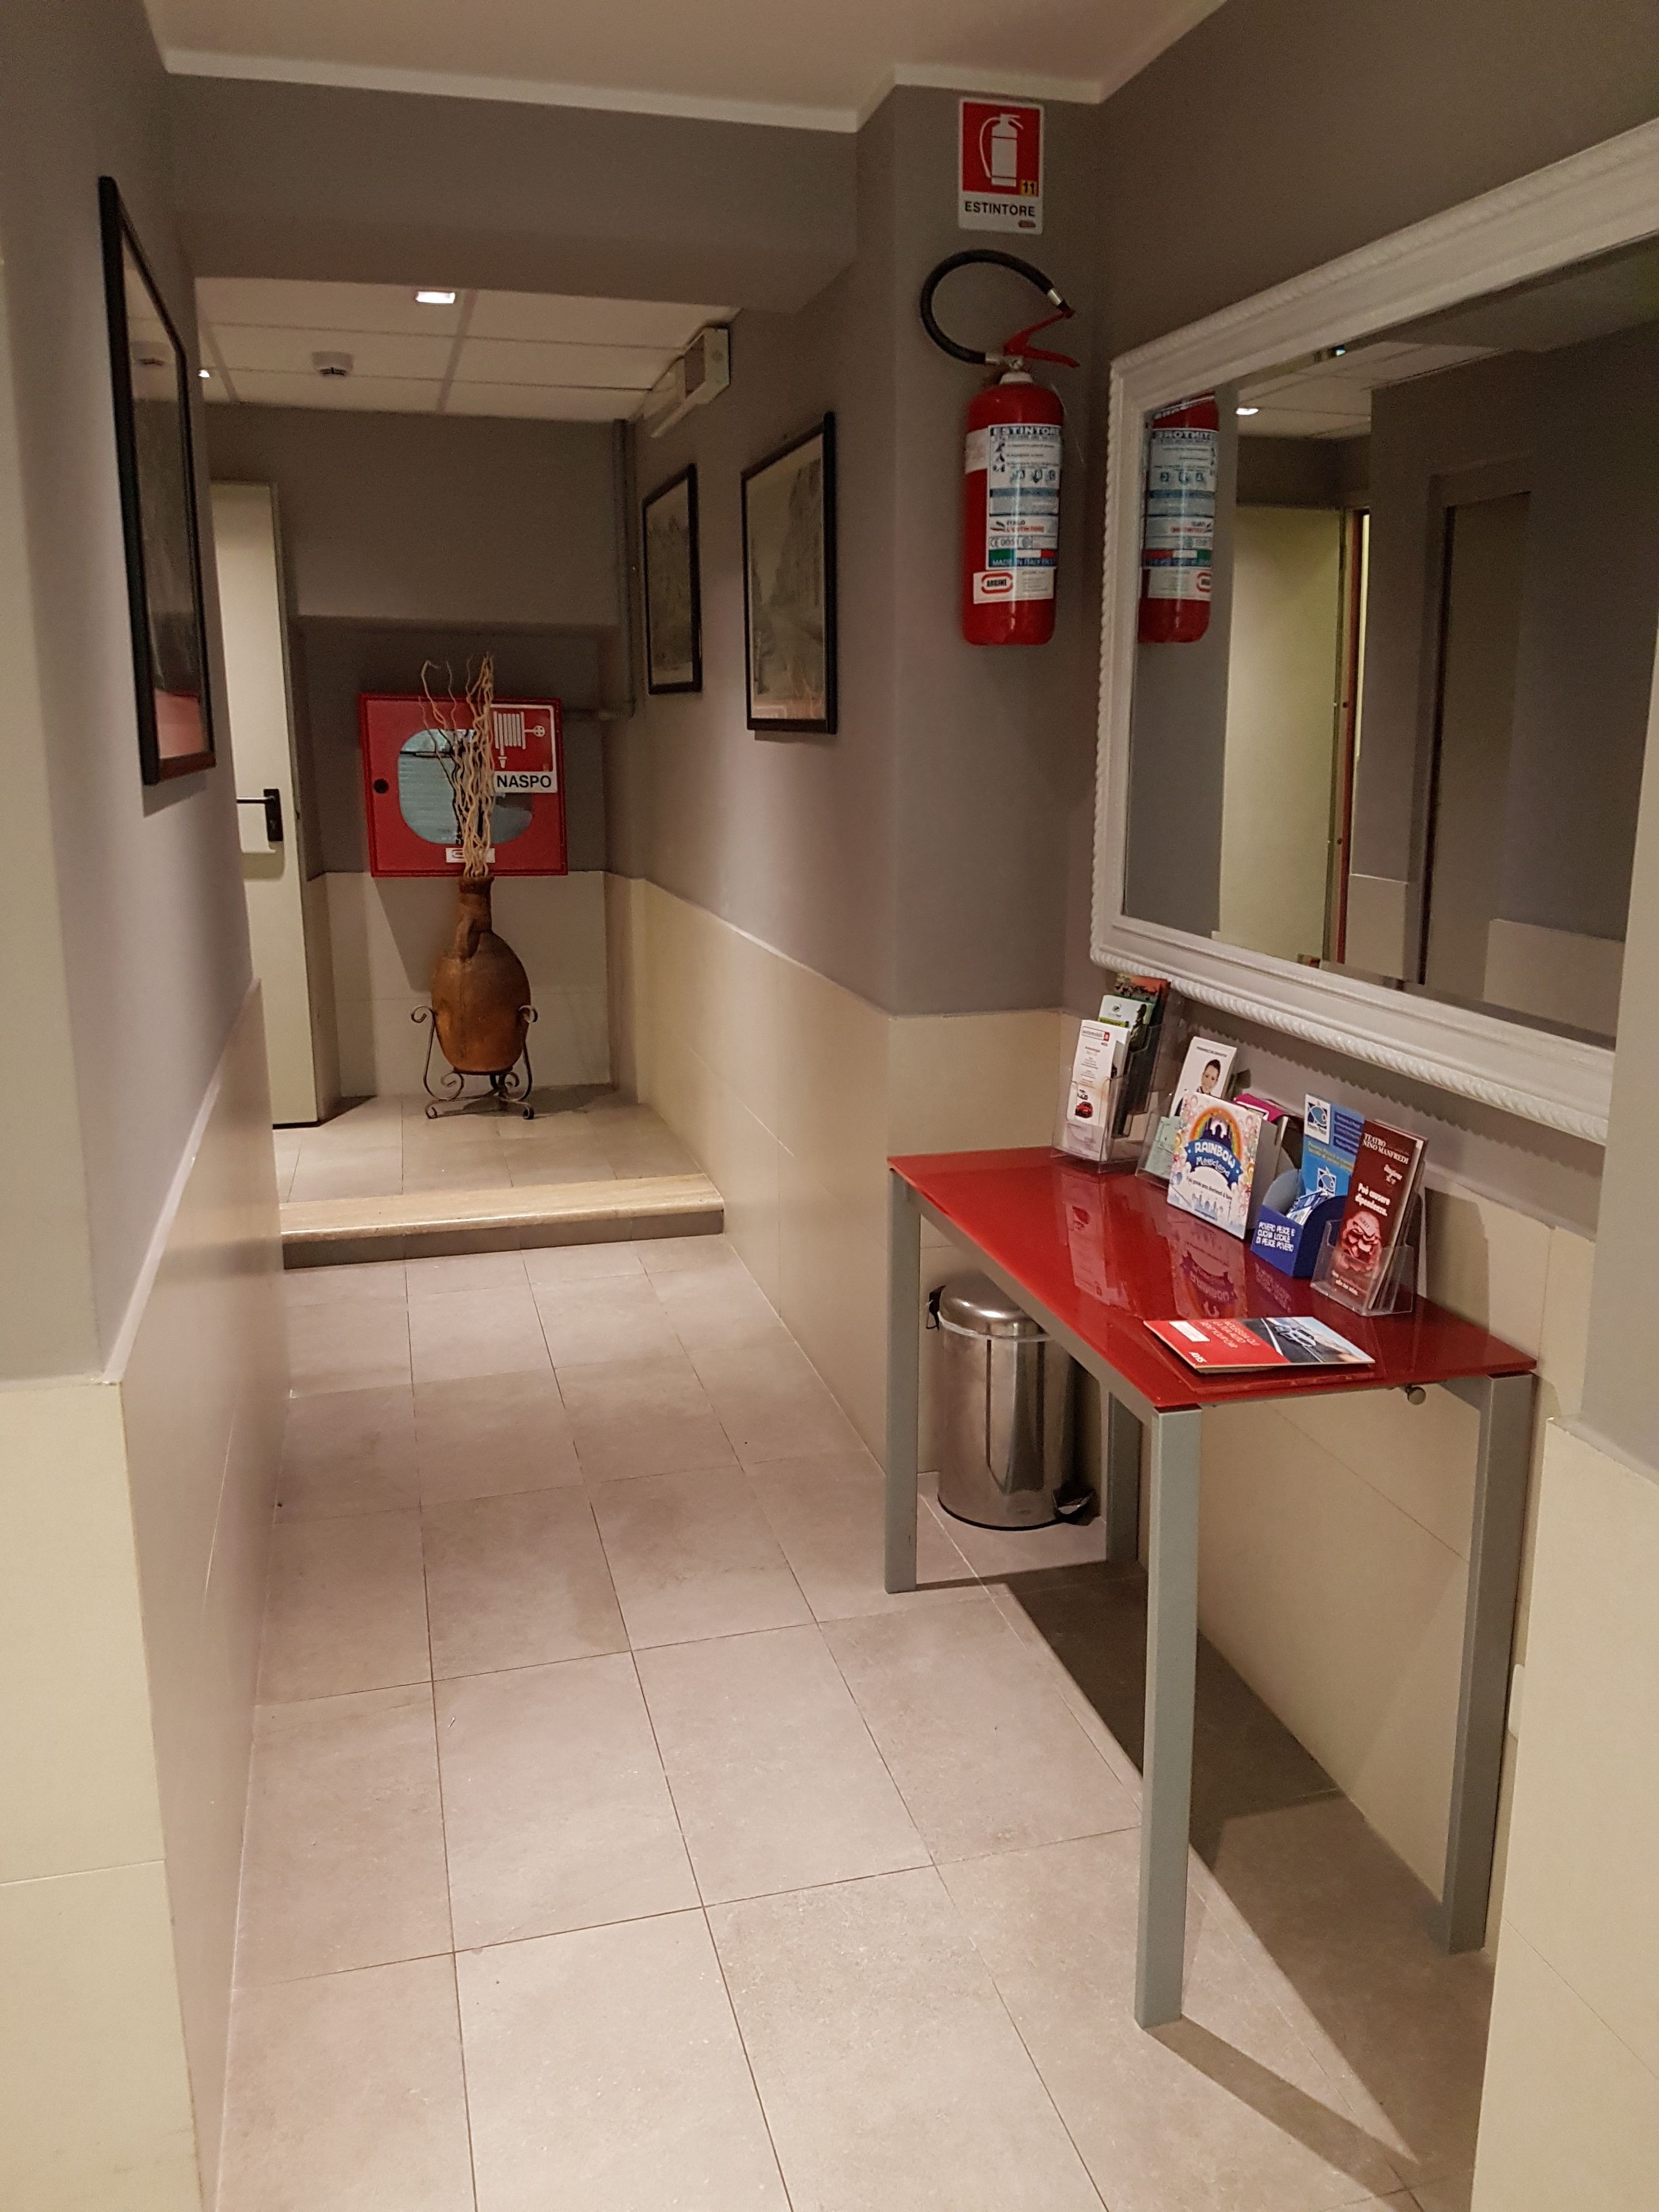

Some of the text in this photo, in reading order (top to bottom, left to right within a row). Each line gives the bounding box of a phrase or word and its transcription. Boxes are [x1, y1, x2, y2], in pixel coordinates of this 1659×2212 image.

[964, 201, 1035, 217] ESTINTORE
[497, 775, 551, 788] NASPO
[1363, 1132, 1386, 1147] TEATRO
[1194, 1142, 1236, 1168] RAINBOW
[1362, 1139, 1378, 1151] NINO
[1378, 1146, 1410, 1164] MANFREDI
[1259, 1221, 1296, 1237] POVERO PESCE E
[1256, 1236, 1294, 1252] DI PESCE POVERO
[1274, 1233, 1290, 1243] LOCALE
[1188, 1351, 1207, 1363] AVIS
